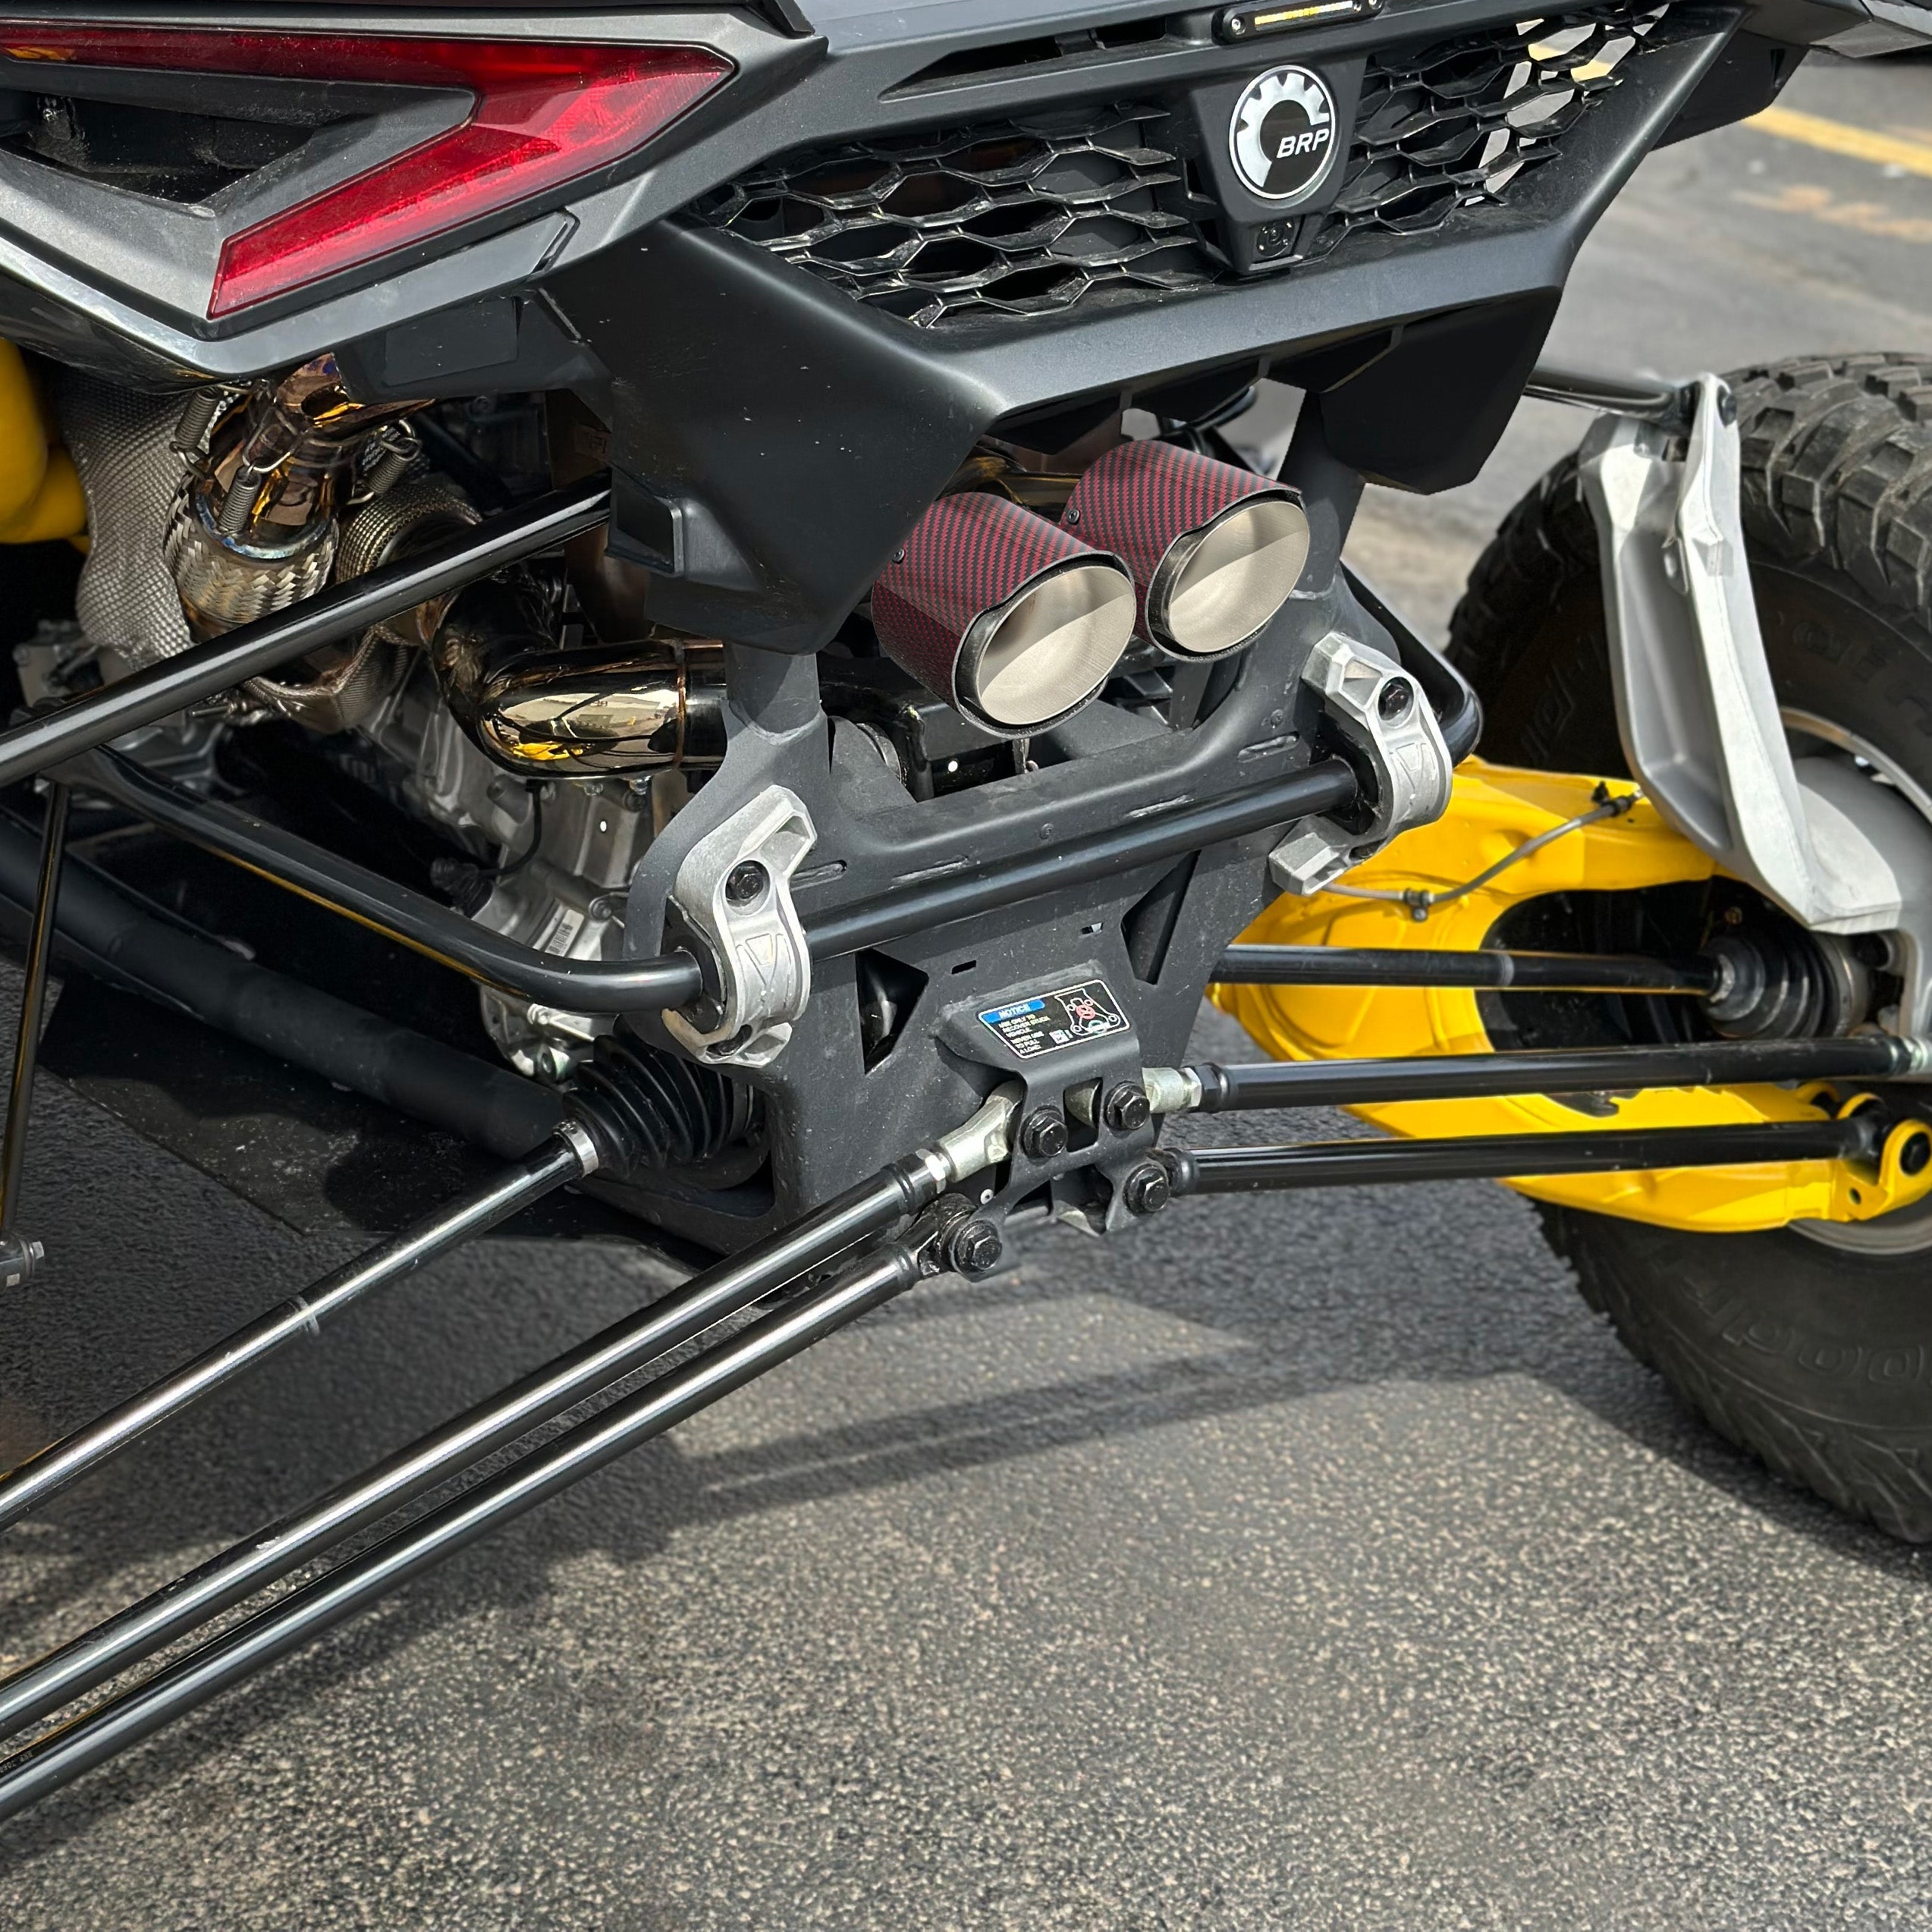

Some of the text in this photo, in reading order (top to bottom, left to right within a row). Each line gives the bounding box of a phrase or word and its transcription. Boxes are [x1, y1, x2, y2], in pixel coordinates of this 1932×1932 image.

[1277, 128, 1330, 159] BRP
[998, 1004, 1031, 1018] NOTICE
[1002, 1016, 1051, 1033] RECOVER STUCK
